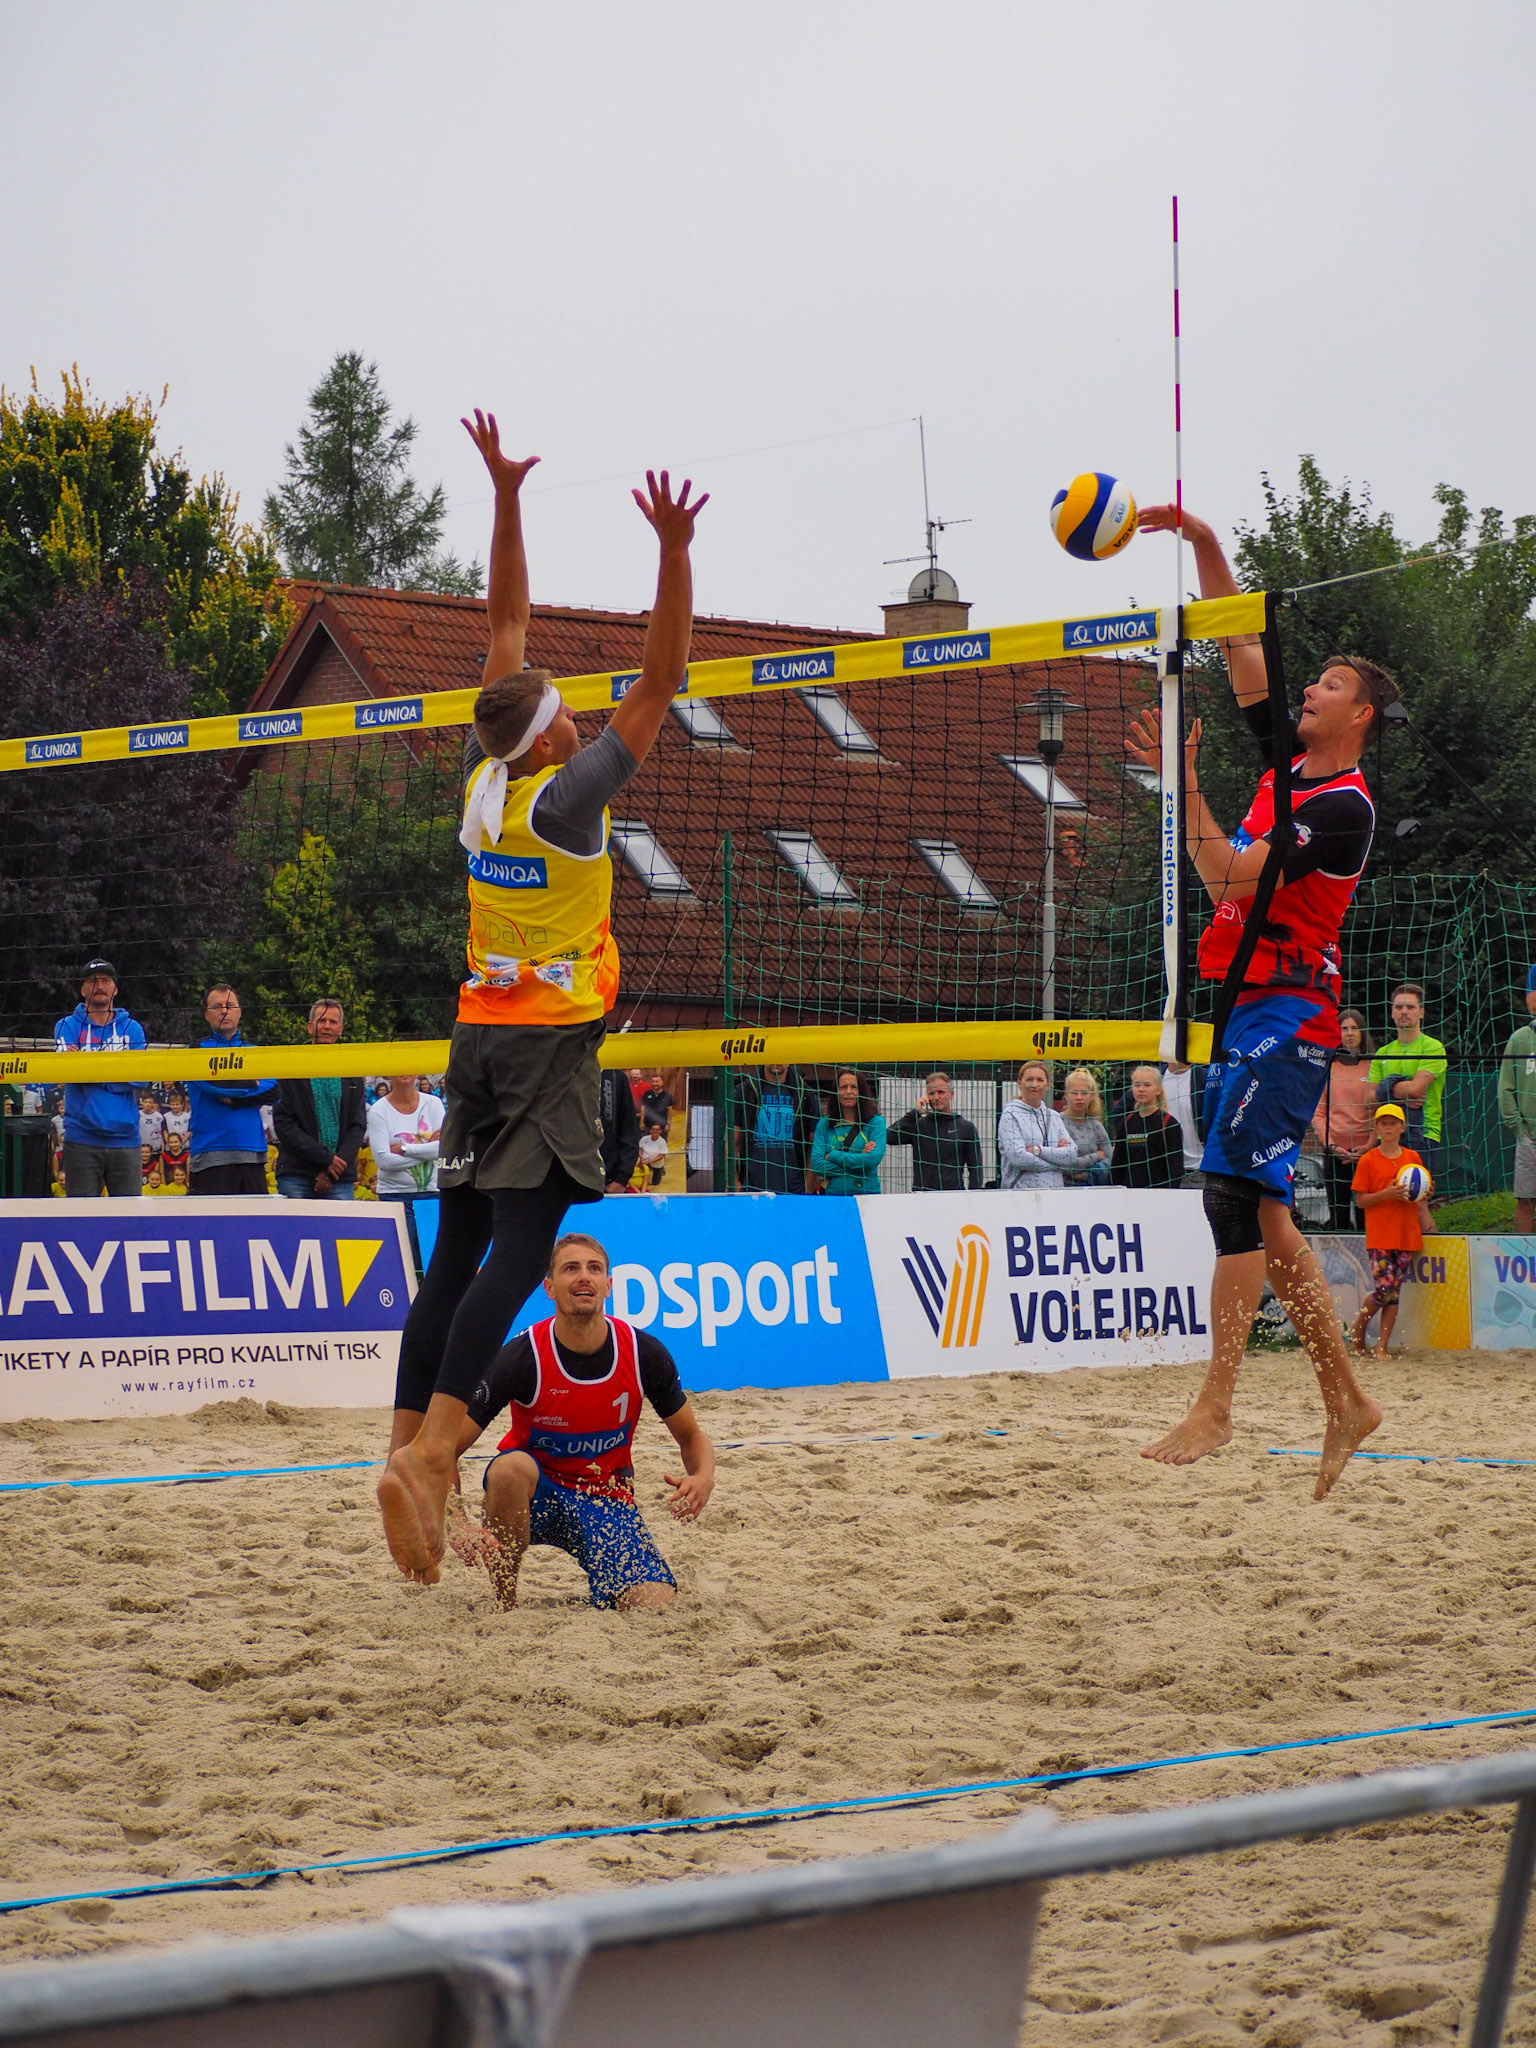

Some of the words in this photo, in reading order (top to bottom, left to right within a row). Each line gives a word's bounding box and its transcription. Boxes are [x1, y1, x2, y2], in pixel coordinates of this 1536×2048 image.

[1096, 620, 1149, 642] UNIQA
[933, 641, 983, 661] UNIQA
[781, 659, 828, 678] UNIQA
[379, 705, 417, 723] UNIQA
[150, 731, 184, 747] UNIQA
[260, 719, 297, 736] UNIQA
[45, 742, 77, 757] UNIQA
[482, 859, 541, 883] UNIQA
[721, 1034, 765, 1060] gala
[1033, 1027, 1083, 1055] gala
[209, 1053, 243, 1076] gala
[1266, 1136, 1296, 1160] UNIQA
[1005, 1223, 1144, 1277] BEACH
[0, 1240, 329, 1316] AYFILM
[1401, 1256, 1446, 1283] ACH
[1010, 1286, 1207, 1344] VOLEJBAL
[78, 1351, 95, 1368] A
[102, 1345, 170, 1367] PAPÍR
[177, 1347, 224, 1365] PRO
[231, 1340, 329, 1363] KVALITNÍ
[333, 1343, 382, 1361] TISK
[121, 1377, 256, 1393] www.rayfilm.cz
[612, 1392, 629, 1423] 1
[567, 1431, 625, 1454] UNIQA
